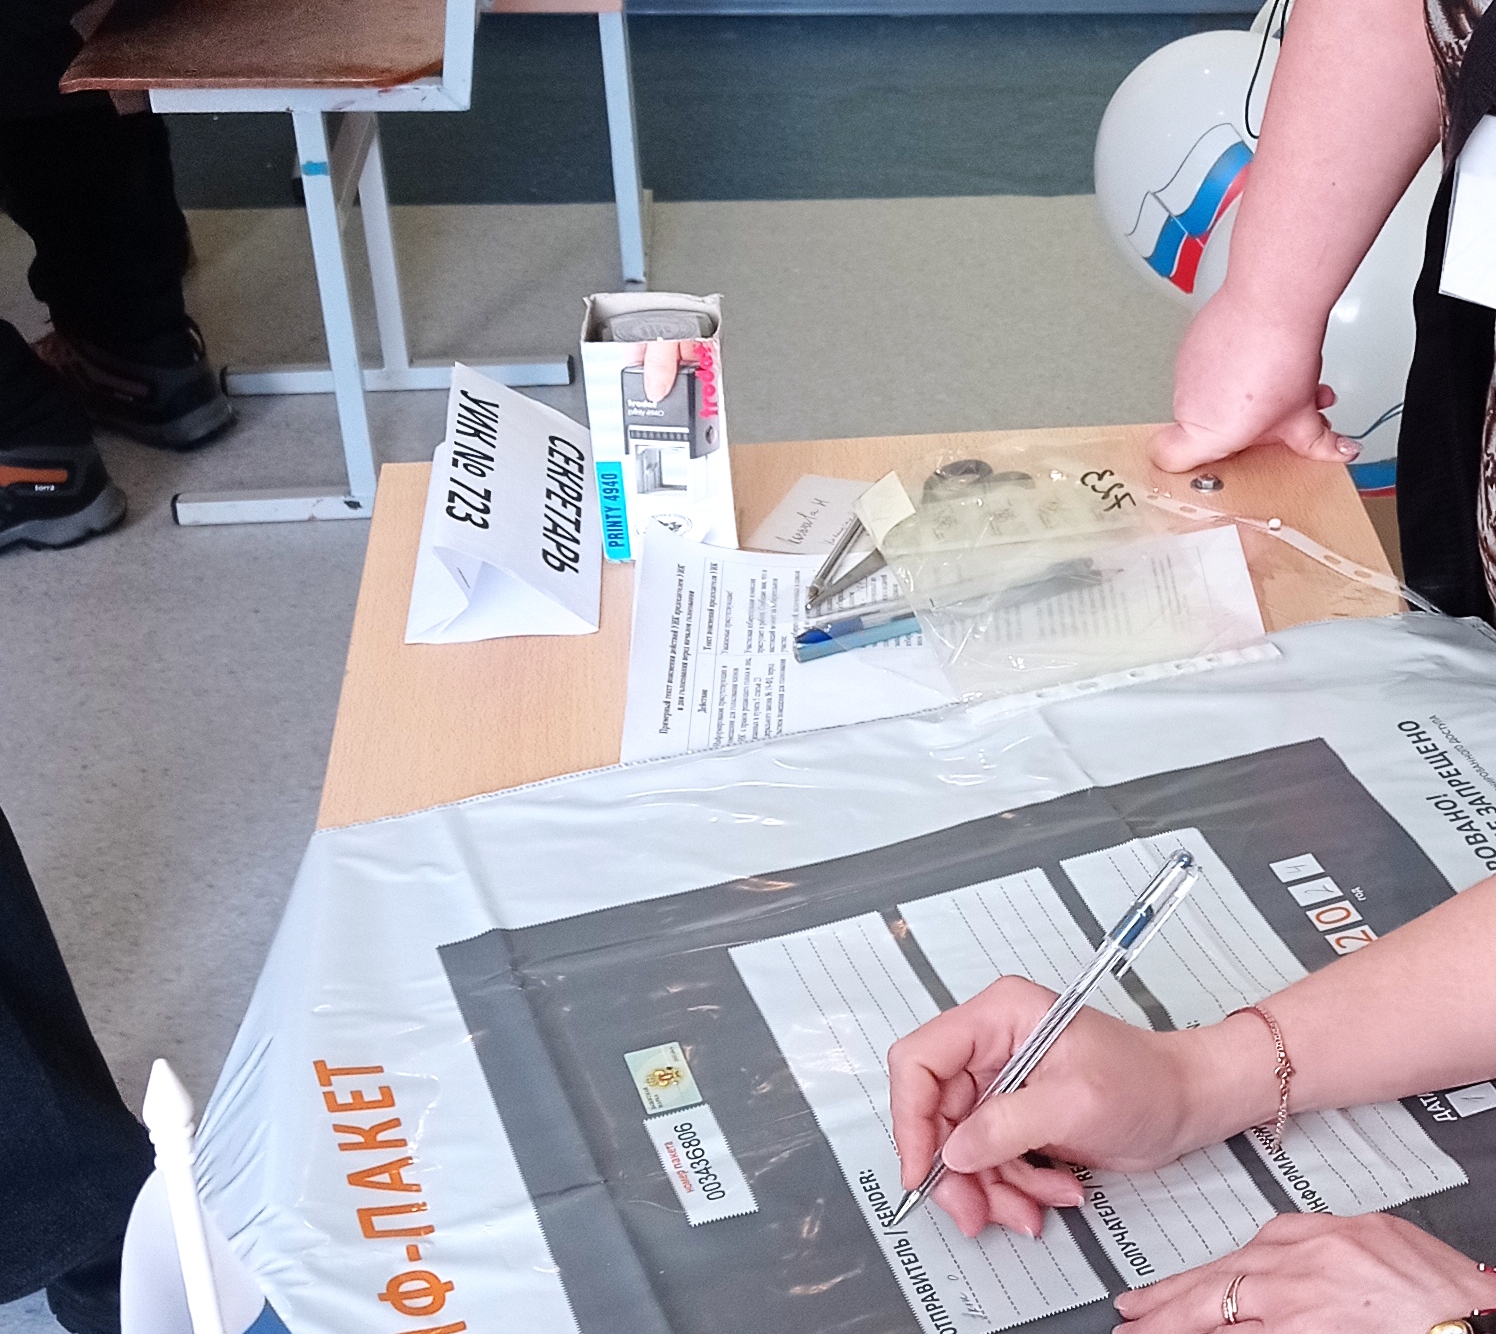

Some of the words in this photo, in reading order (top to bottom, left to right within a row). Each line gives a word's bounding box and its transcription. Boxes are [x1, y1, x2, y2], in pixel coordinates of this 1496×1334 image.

[692, 342, 720, 419] trodat
[454, 388, 500, 450] УИК
[451, 440, 495, 479] №
[445, 477, 492, 531] 723
[540, 434, 587, 575] СЕКРЕТАРЬ
[600, 472, 620, 502] 4940
[602, 504, 625, 549] PRINTY
[1350, 886, 1367, 902] год
[664, 1140, 684, 1169] пакета
[673, 1122, 726, 1201] 003436806
[676, 1169, 695, 1194] номер
[1089, 1191, 1155, 1277] ПОЛУЧАТЕЛЬ
